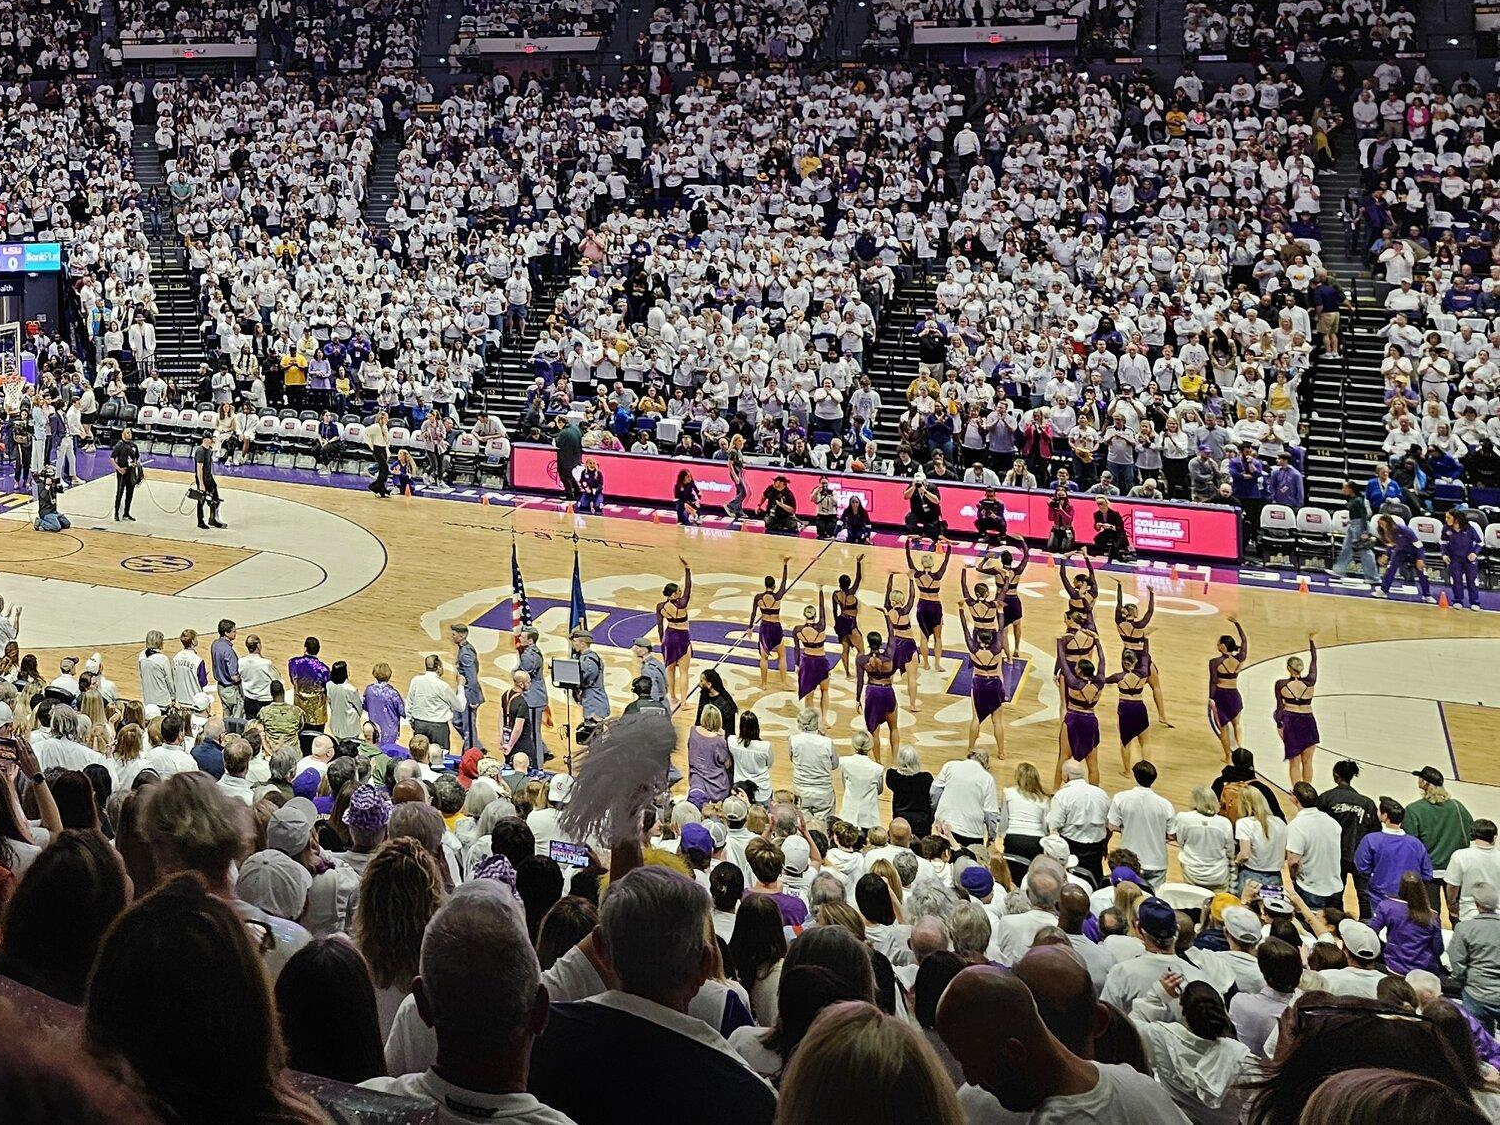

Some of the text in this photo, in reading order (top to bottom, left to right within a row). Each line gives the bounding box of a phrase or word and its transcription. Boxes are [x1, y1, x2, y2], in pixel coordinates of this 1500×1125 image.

[2, 246, 22, 255] LSU
[8, 258, 18, 270] 0
[1134, 518, 1182, 530] COLLEGE
[1134, 526, 1185, 539] GAMEDAY
